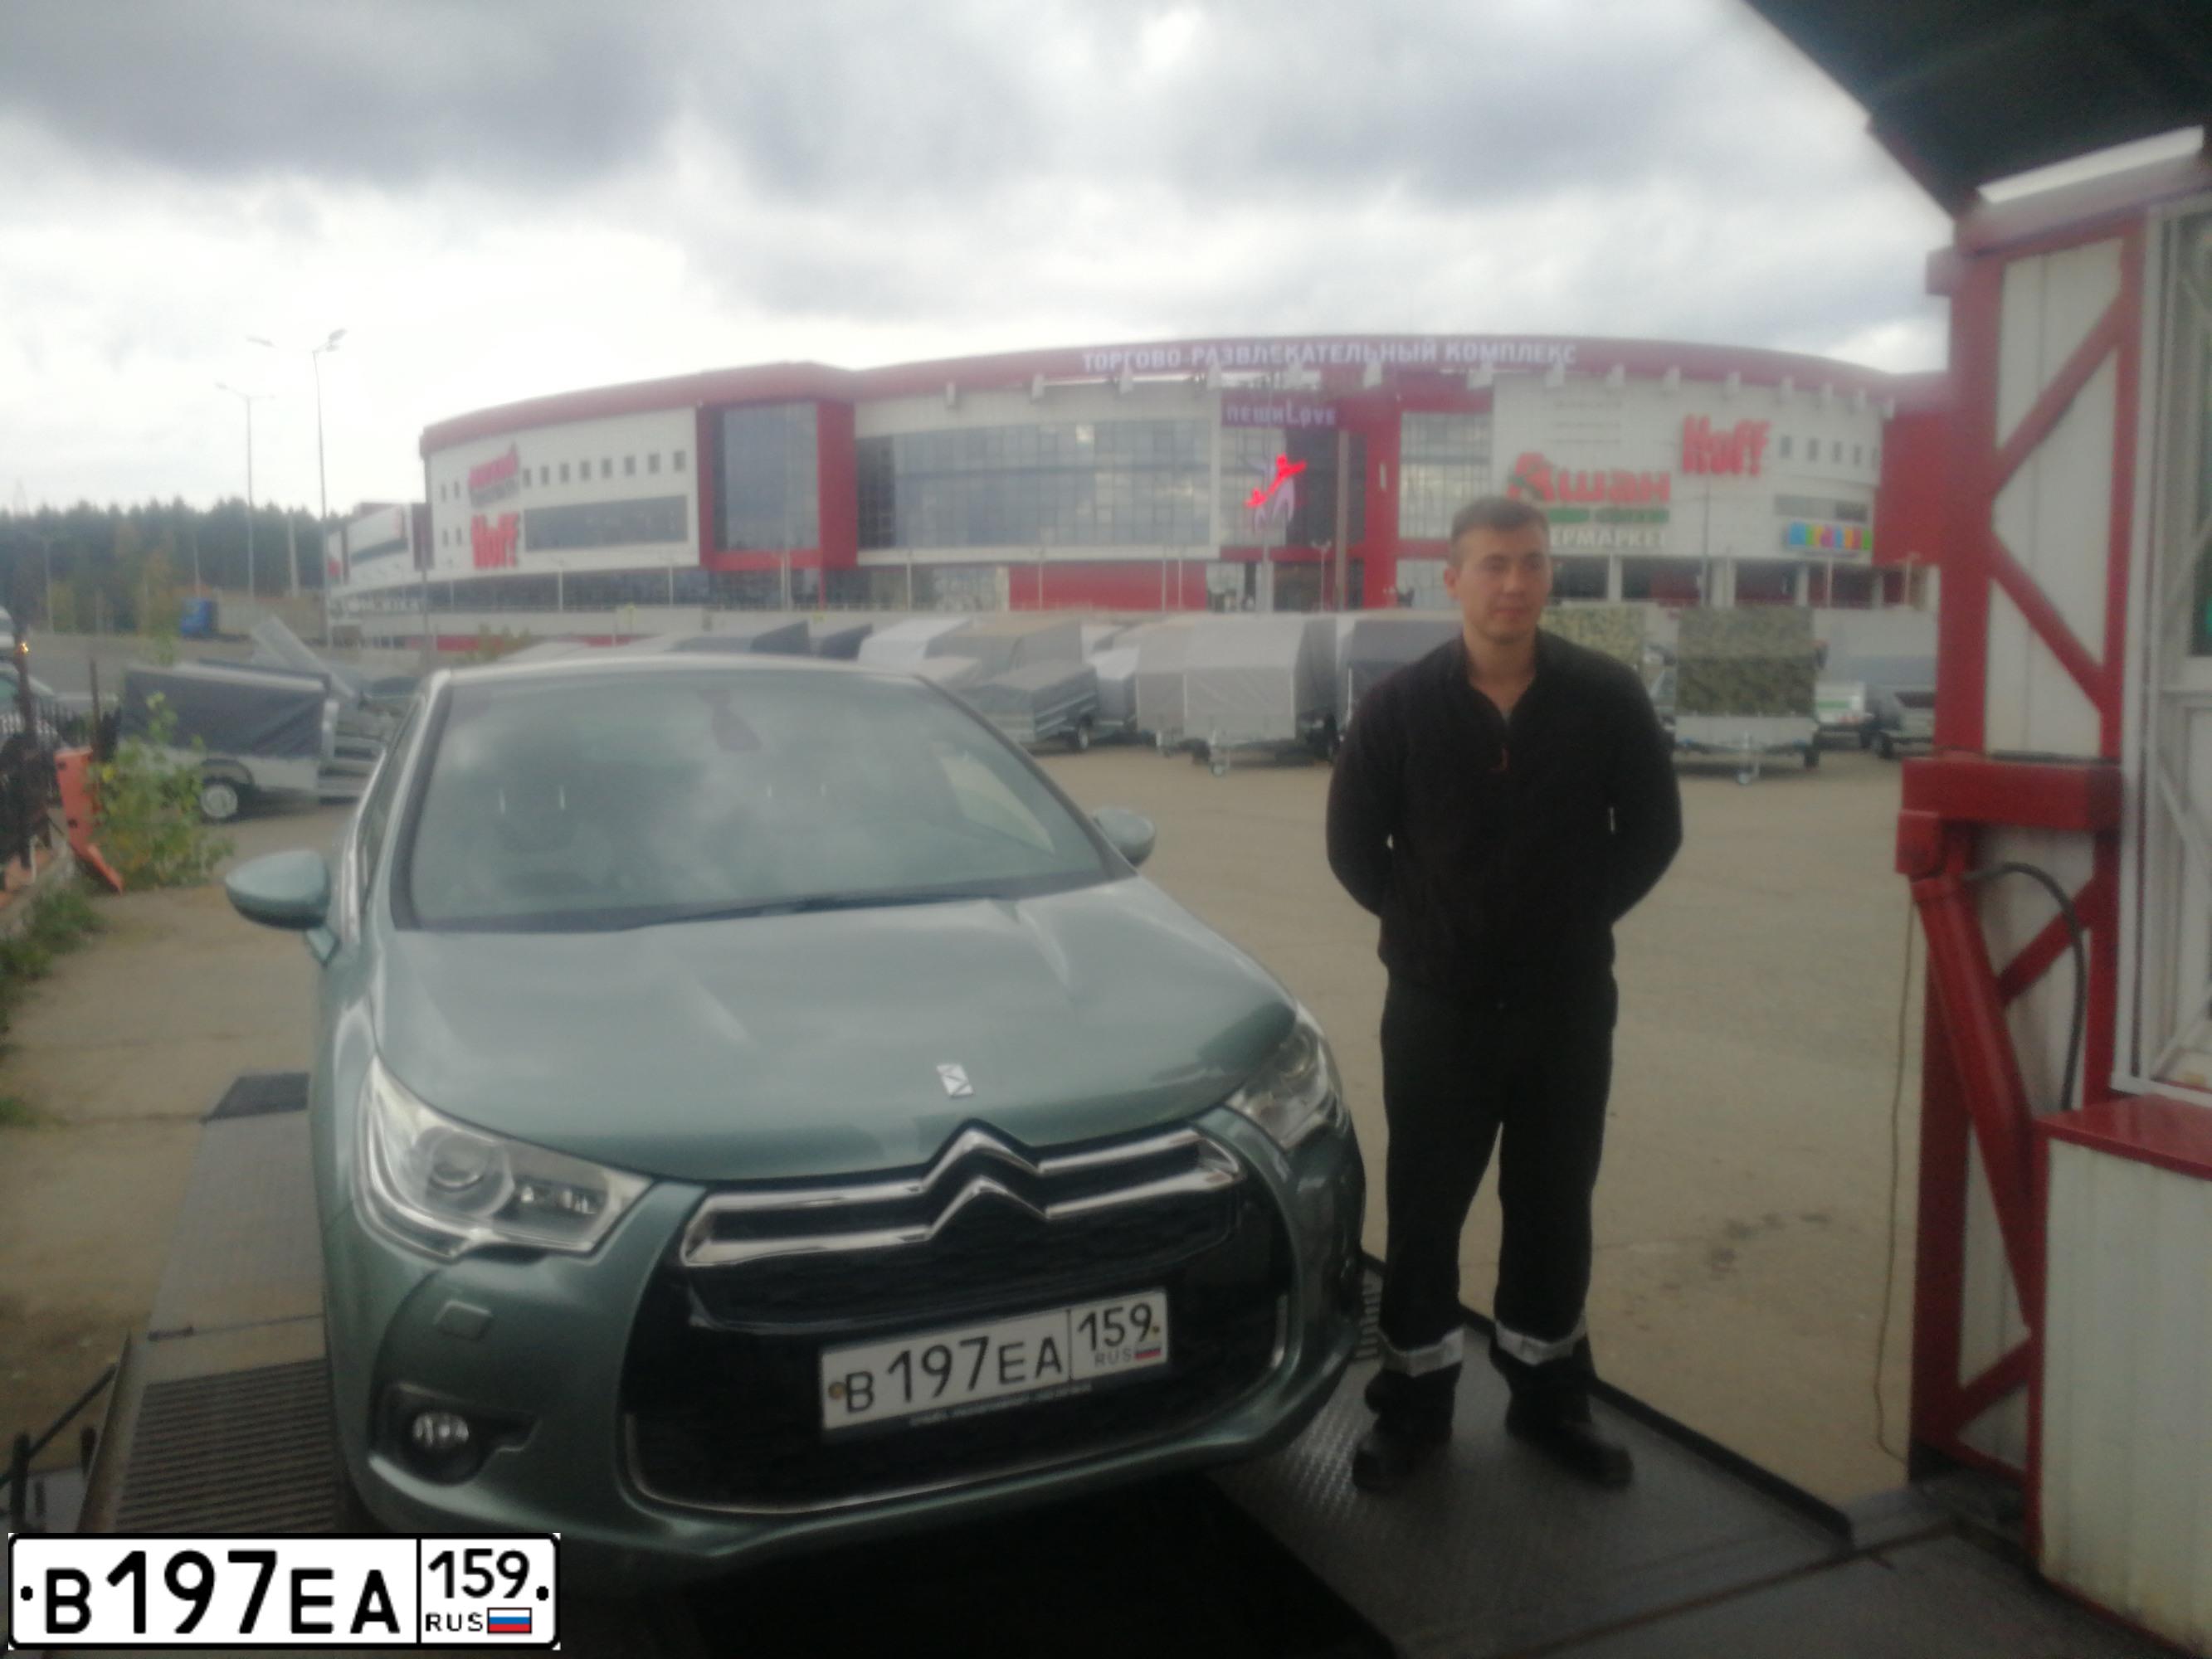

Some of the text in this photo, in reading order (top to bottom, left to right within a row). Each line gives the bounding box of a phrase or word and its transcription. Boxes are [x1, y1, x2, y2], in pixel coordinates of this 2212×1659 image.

[1082, 337, 1577, 372] ТОРГОВО РАЗВЛЕКАТЕЛЬНЫЙ КОМПЛЕКС
[845, 1335, 1062, 1413] В197ЕА
[1078, 1303, 1152, 1351] 159
[1094, 1347, 1133, 1367] RUS
